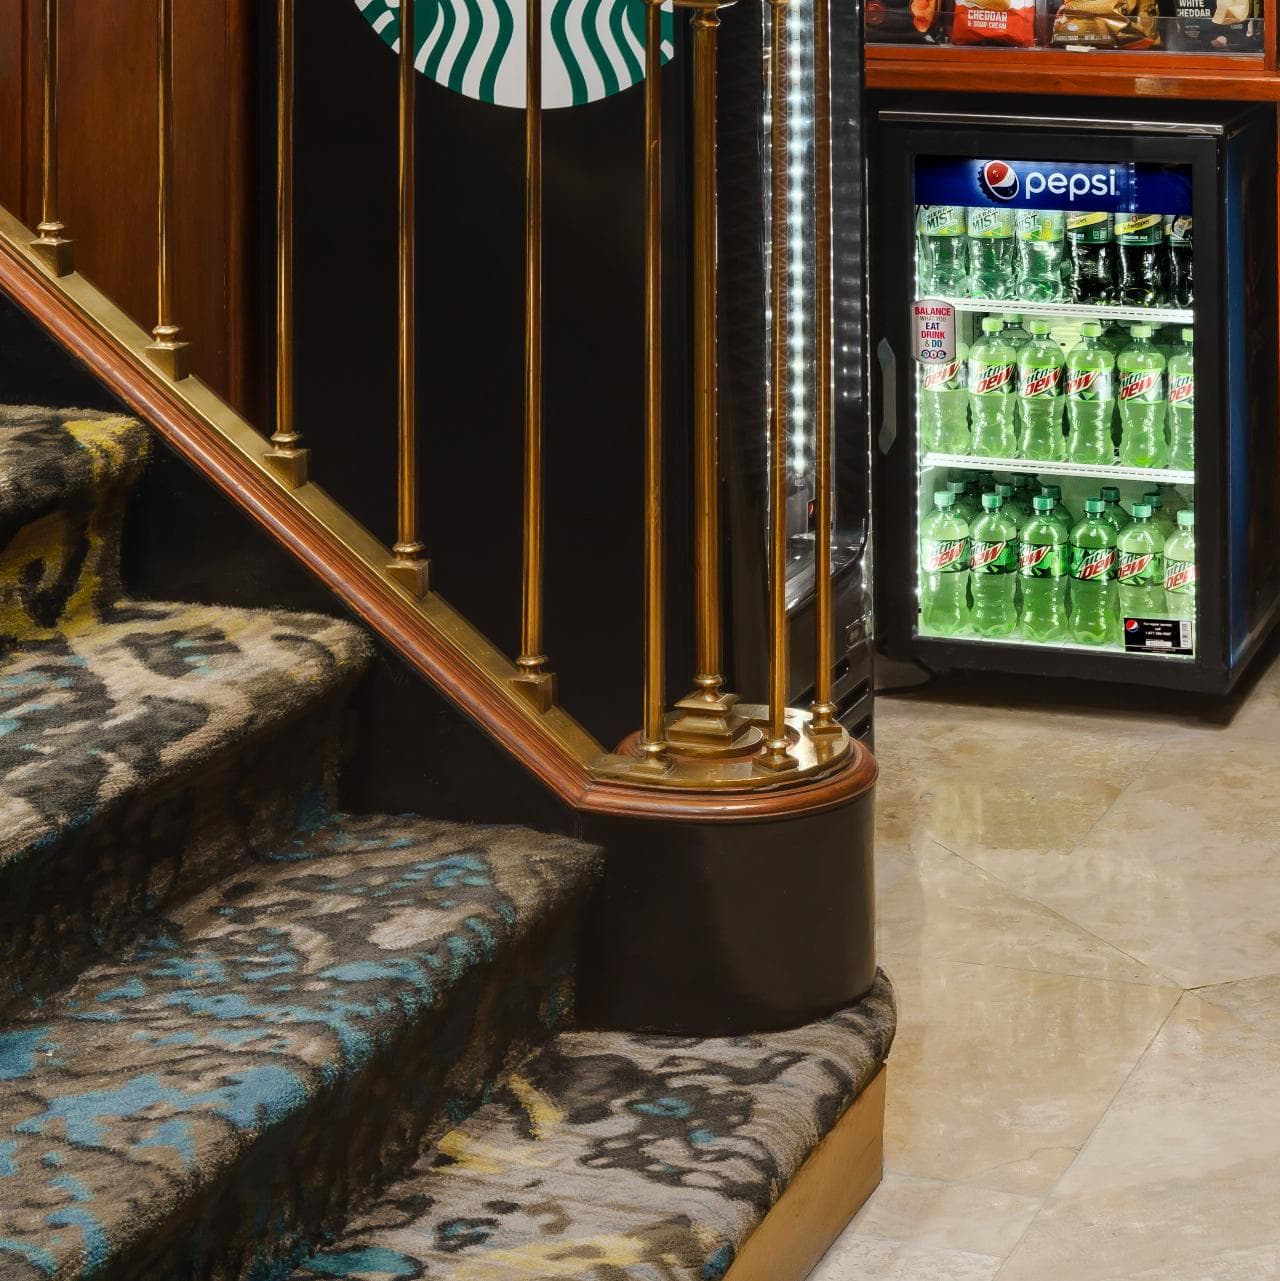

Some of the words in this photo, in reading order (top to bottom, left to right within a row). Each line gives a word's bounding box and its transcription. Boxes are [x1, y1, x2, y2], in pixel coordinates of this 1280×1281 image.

[967, 9, 1008, 21] CHEDDAR
[1176, 7, 1211, 17] CHEDDAR
[1025, 168, 1117, 201] pepsi
[926, 208, 954, 231] MIST
[972, 211, 998, 233] MIST
[914, 306, 952, 316] BALANCE
[925, 322, 940, 330] EAT
[921, 331, 945, 339] DRINK
